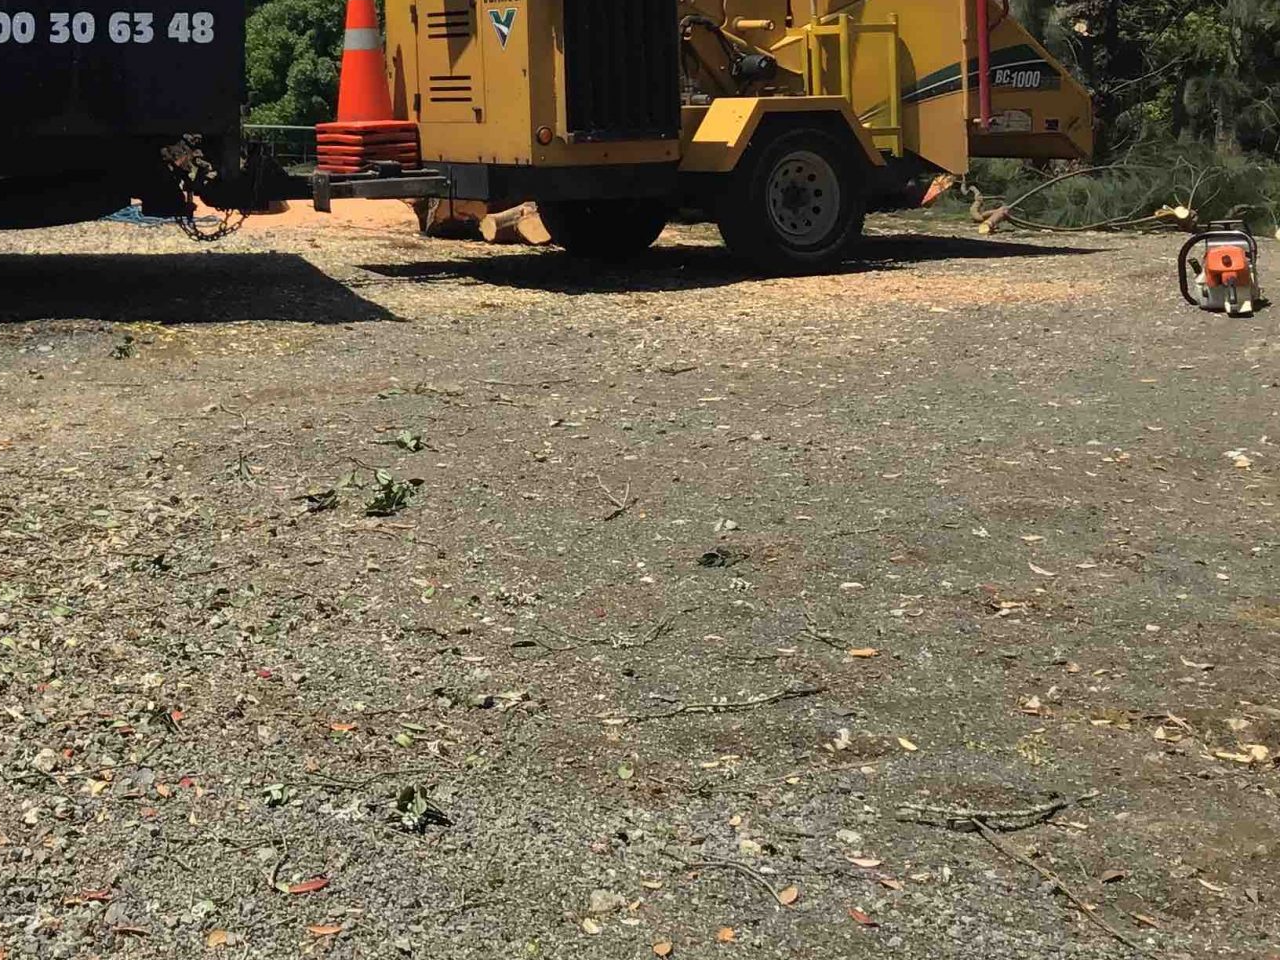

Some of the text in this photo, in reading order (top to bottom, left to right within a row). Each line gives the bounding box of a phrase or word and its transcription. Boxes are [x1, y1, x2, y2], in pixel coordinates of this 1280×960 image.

[49, 11, 96, 44] 30
[108, 11, 154, 44] 63
[167, 11, 214, 44] 48
